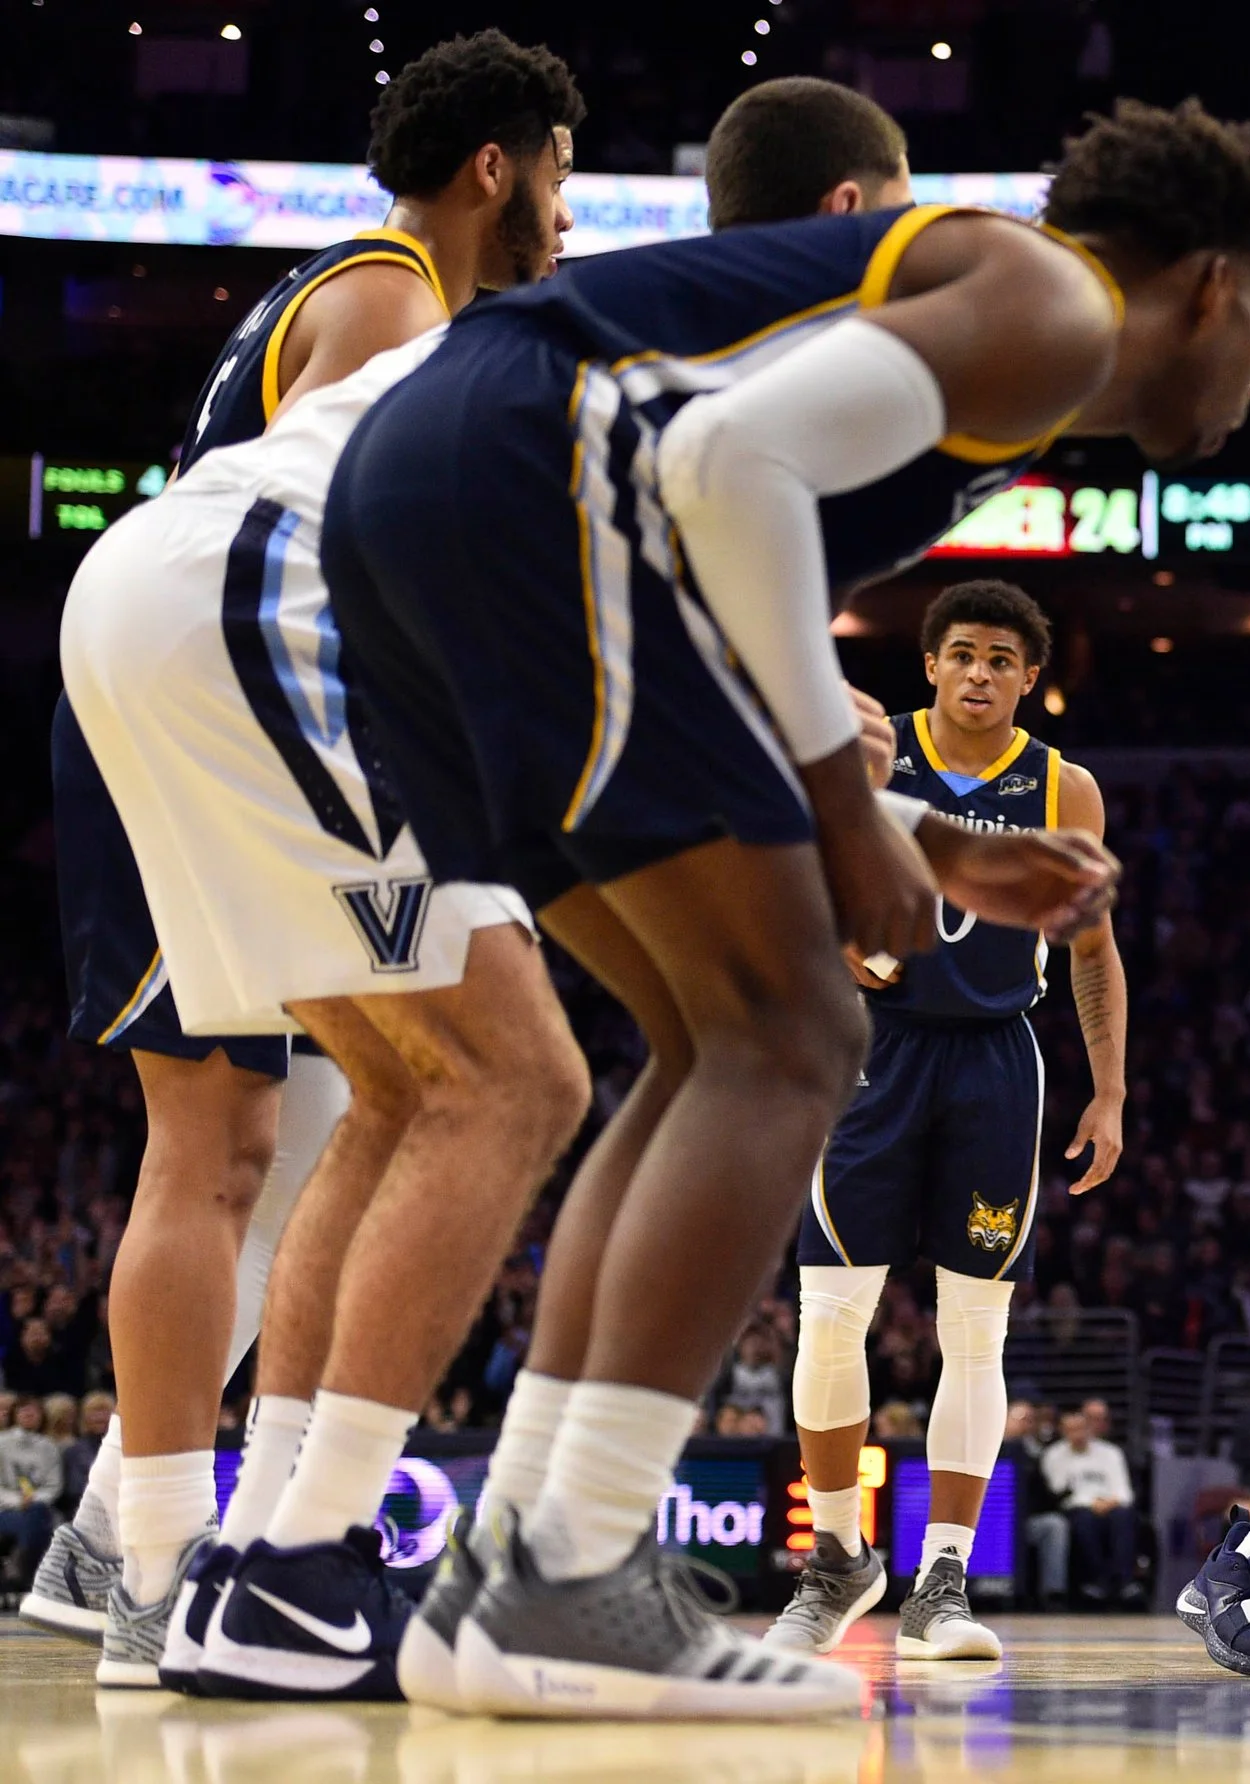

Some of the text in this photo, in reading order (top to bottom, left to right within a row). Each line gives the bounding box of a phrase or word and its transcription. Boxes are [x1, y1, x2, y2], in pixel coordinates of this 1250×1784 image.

[44, 466, 125, 494] FOULS
[1070, 487, 1140, 553] 24
[331, 877, 432, 974] V
